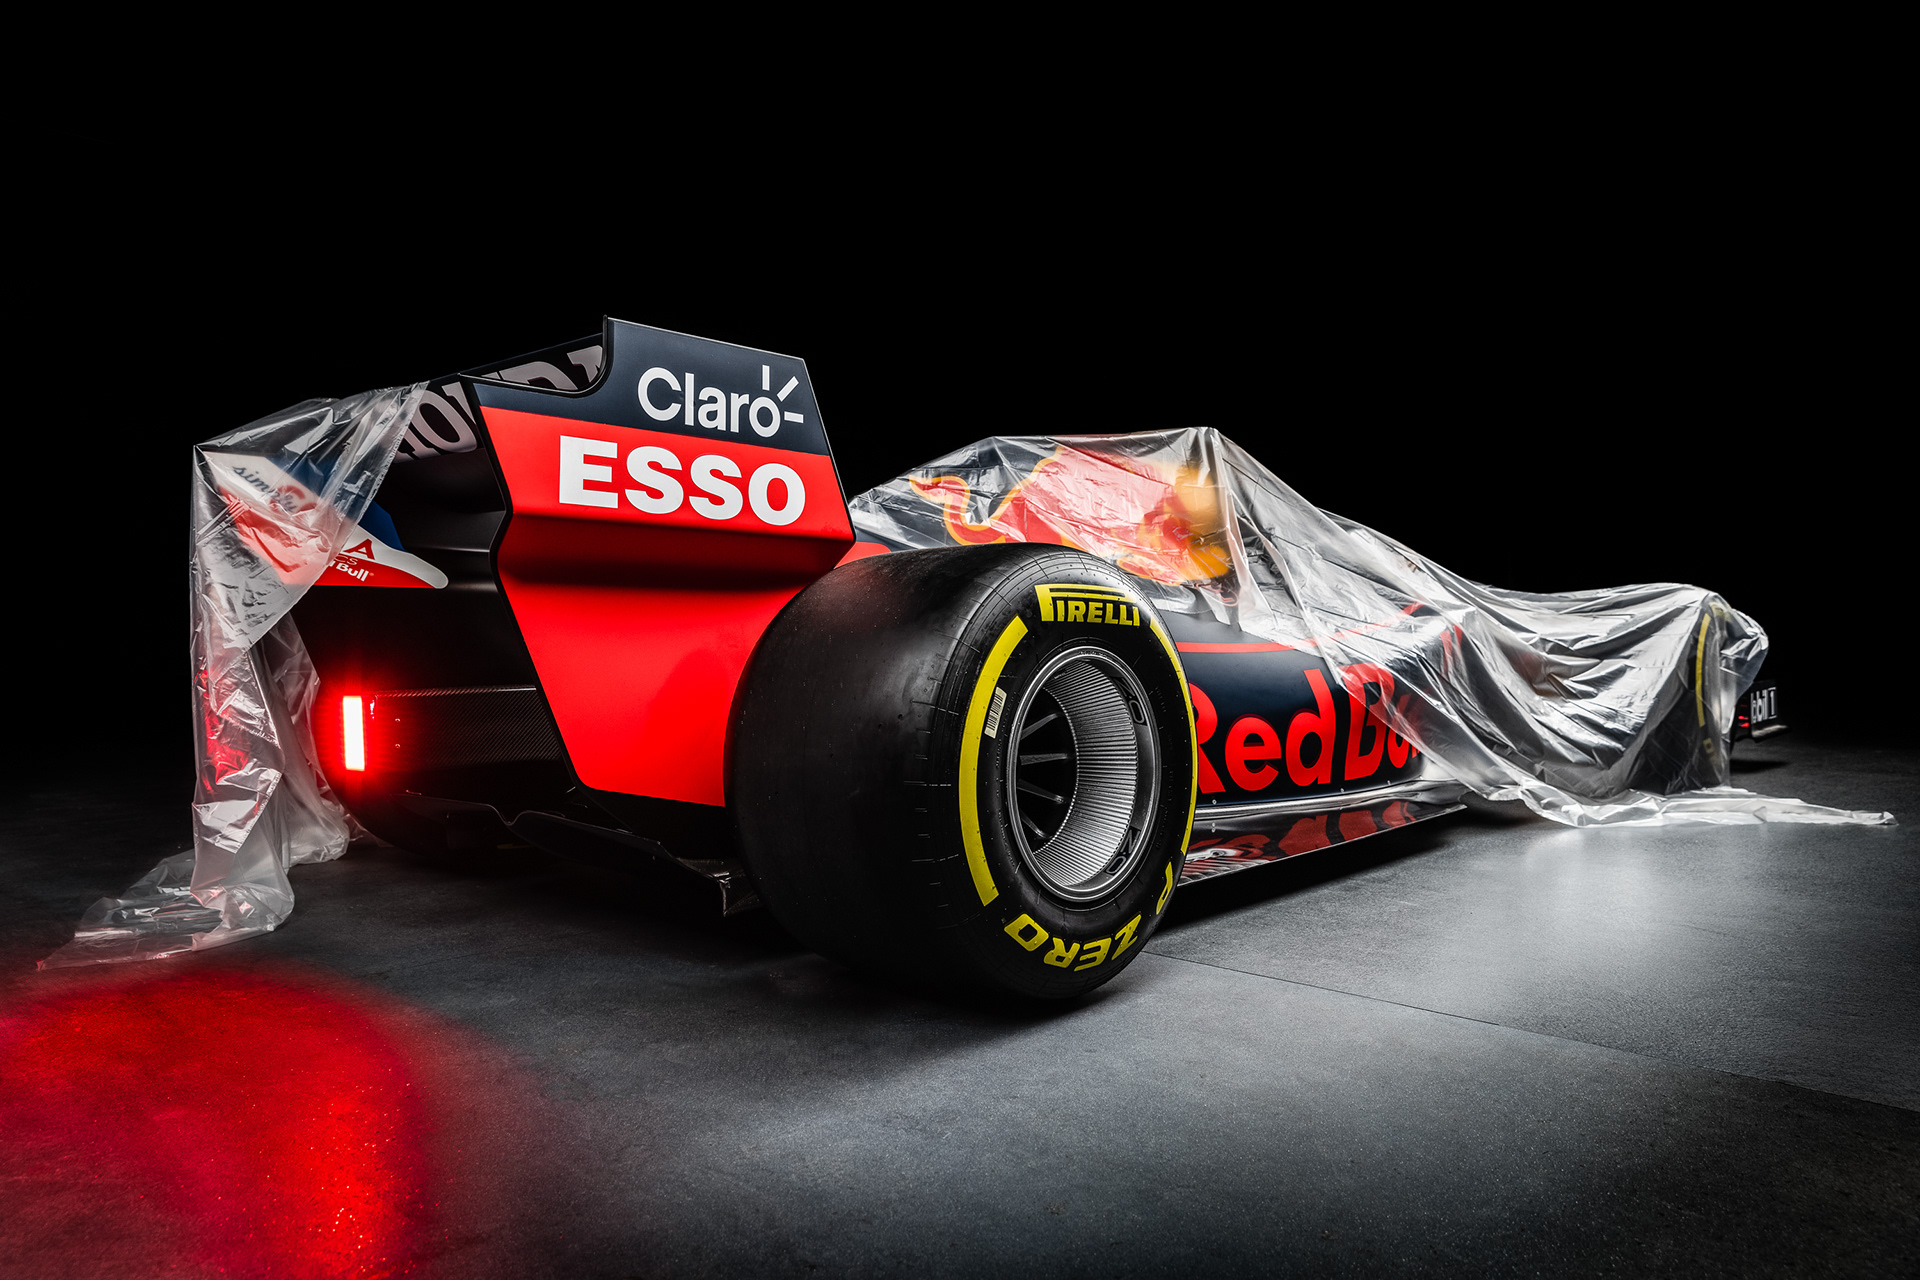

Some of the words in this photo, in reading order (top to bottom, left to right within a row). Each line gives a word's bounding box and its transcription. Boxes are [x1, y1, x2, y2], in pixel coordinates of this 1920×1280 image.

[637, 366, 782, 438] Claro
[558, 434, 806, 526] ESSO
[1034, 583, 1140, 627] PIRELLI
[1188, 668, 1337, 794] Red
[1003, 913, 1142, 972] ZERO
